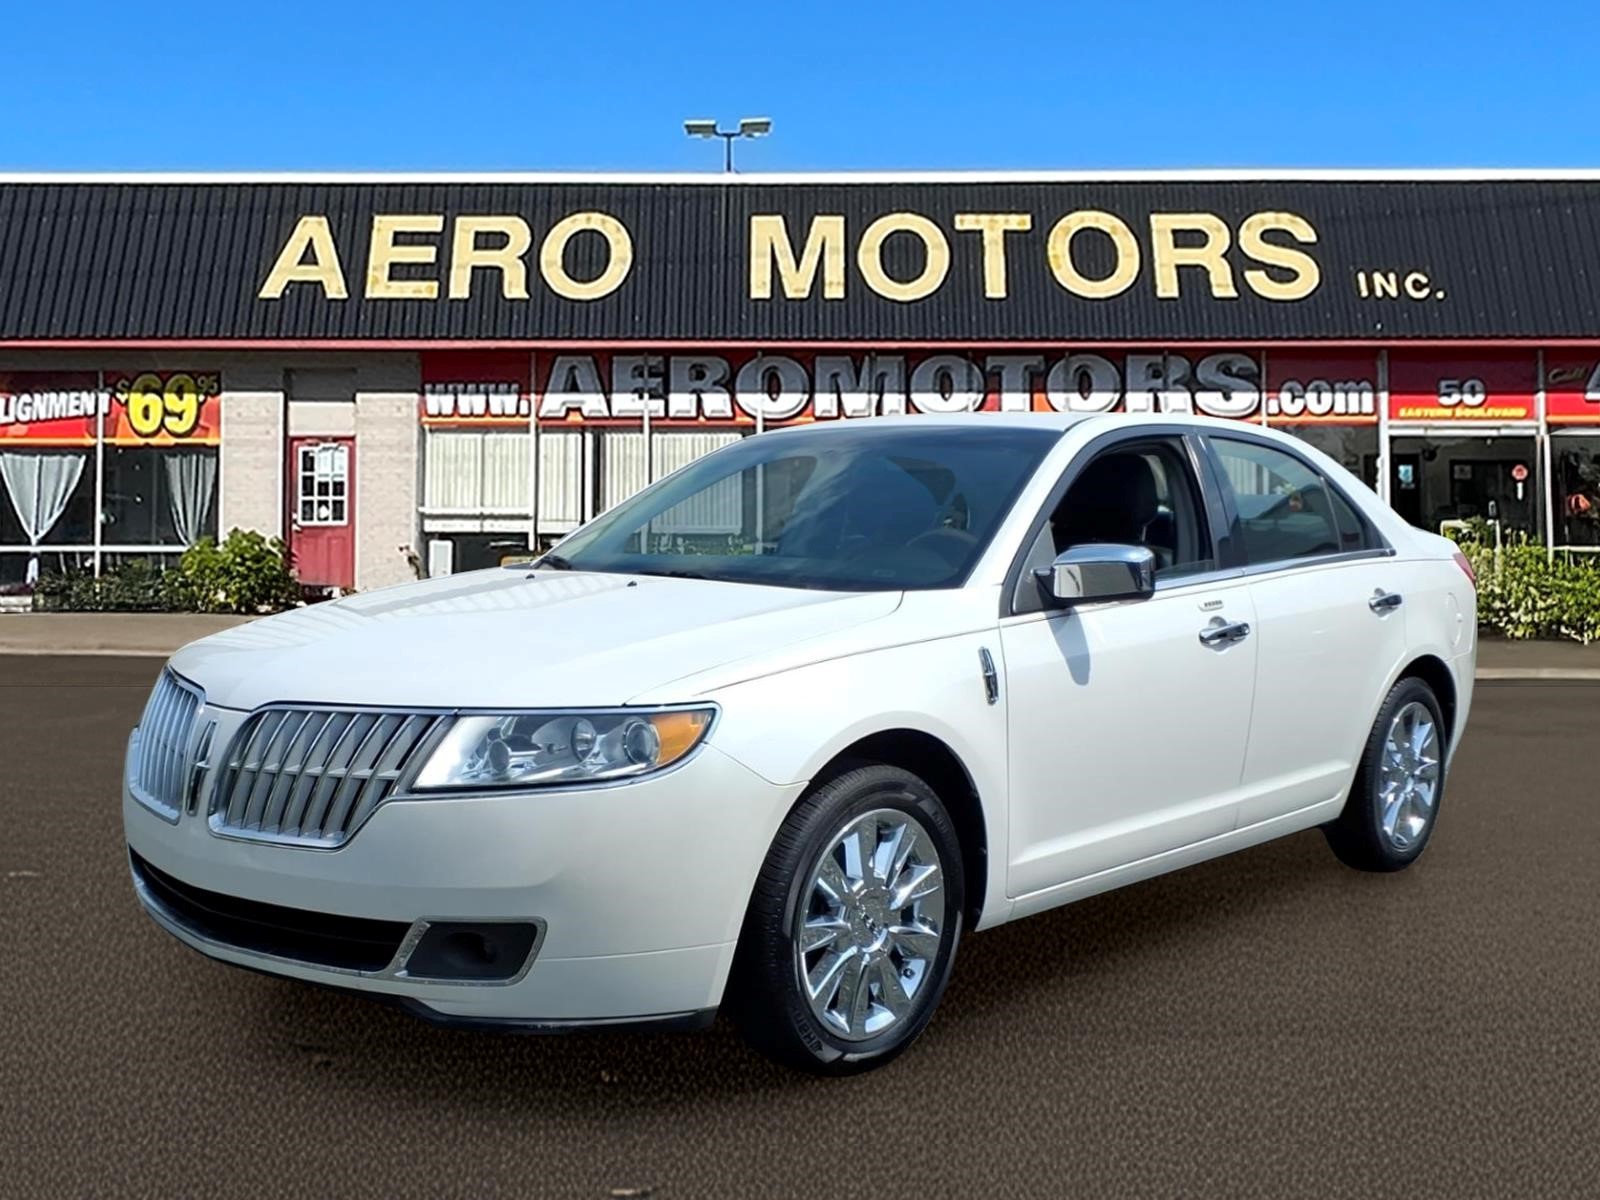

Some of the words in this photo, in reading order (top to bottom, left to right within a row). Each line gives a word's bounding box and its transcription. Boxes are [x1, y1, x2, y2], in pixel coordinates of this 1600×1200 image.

[258, 212, 634, 301] AERO
[750, 210, 1320, 302] MOTORS
[1357, 271, 1446, 300] INC.
[1438, 379, 1485, 406] 50
[1399, 407, 1452, 418] EASTERN
[1455, 407, 1527, 418] BOULEVARD
